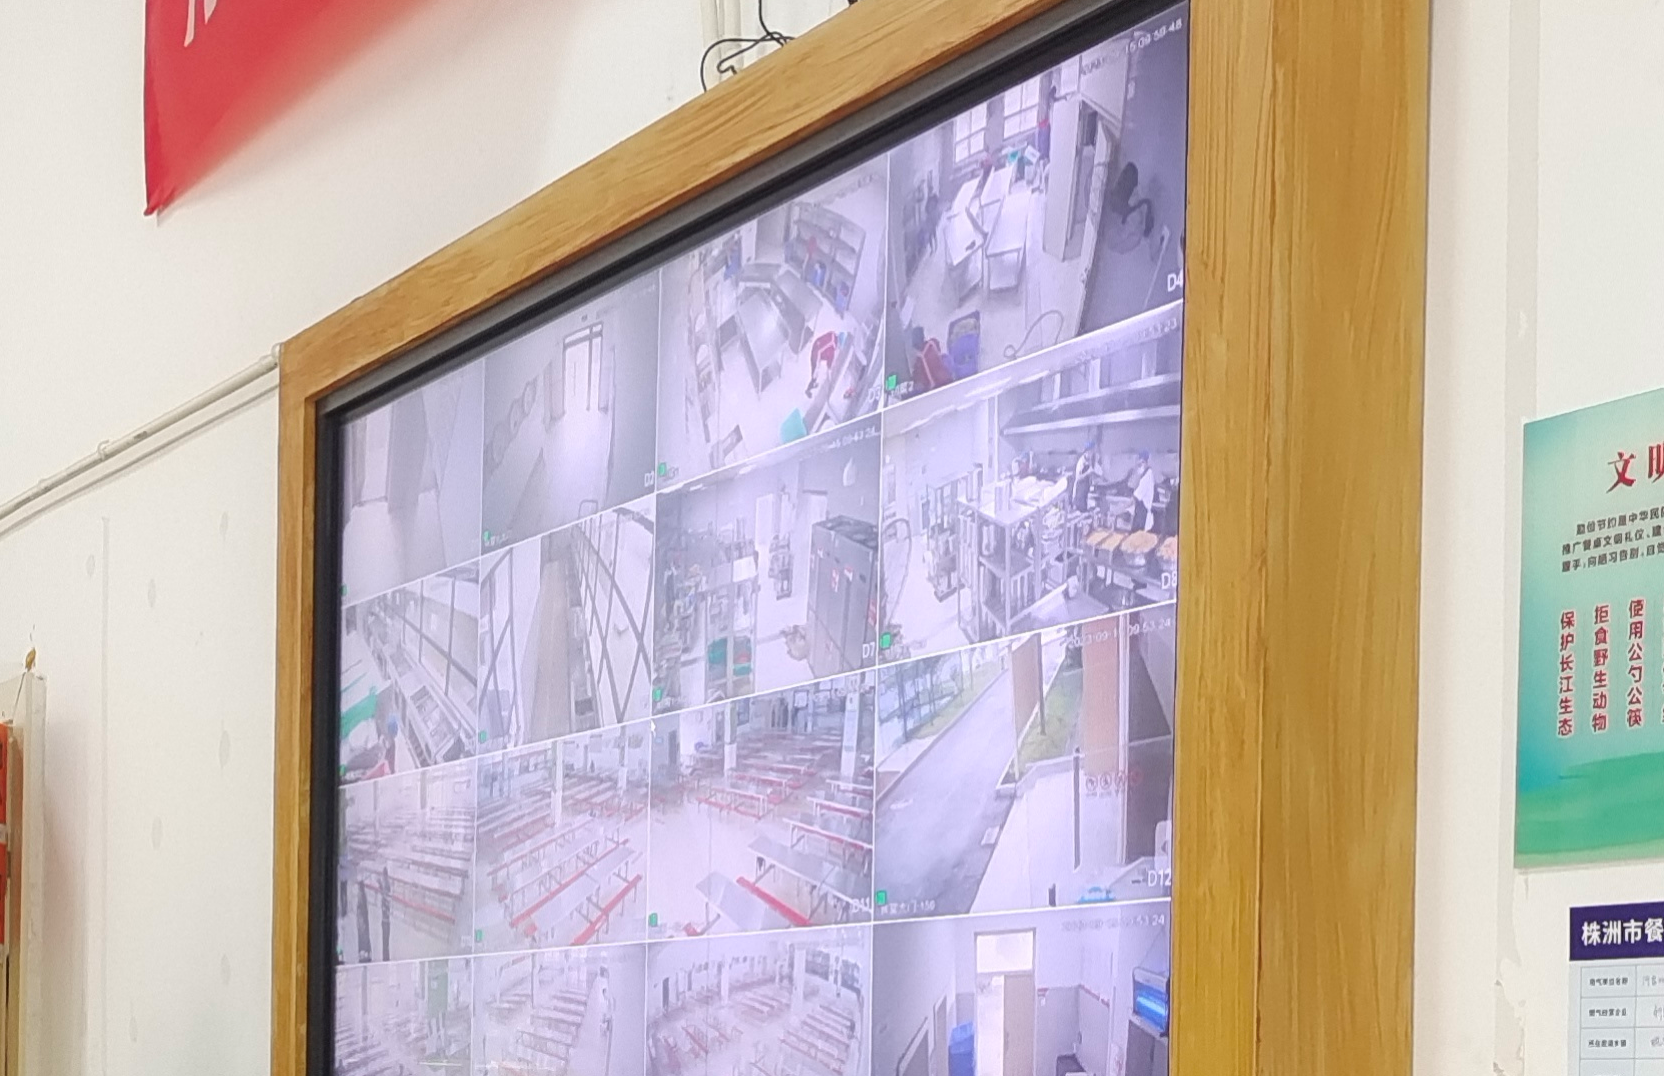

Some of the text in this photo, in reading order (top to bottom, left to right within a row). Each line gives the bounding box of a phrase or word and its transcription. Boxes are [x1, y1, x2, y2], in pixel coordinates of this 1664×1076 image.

[1167, 267, 1184, 292] D4
[1161, 570, 1177, 590] D8
[1558, 610, 1575, 737] 保护长江生态
[1592, 604, 1609, 733] 拒食野生动物
[1627, 598, 1645, 728] 使用公勺公筷
[1147, 868, 1172, 887] D12
[1581, 917, 1664, 946] 株洲市餐
